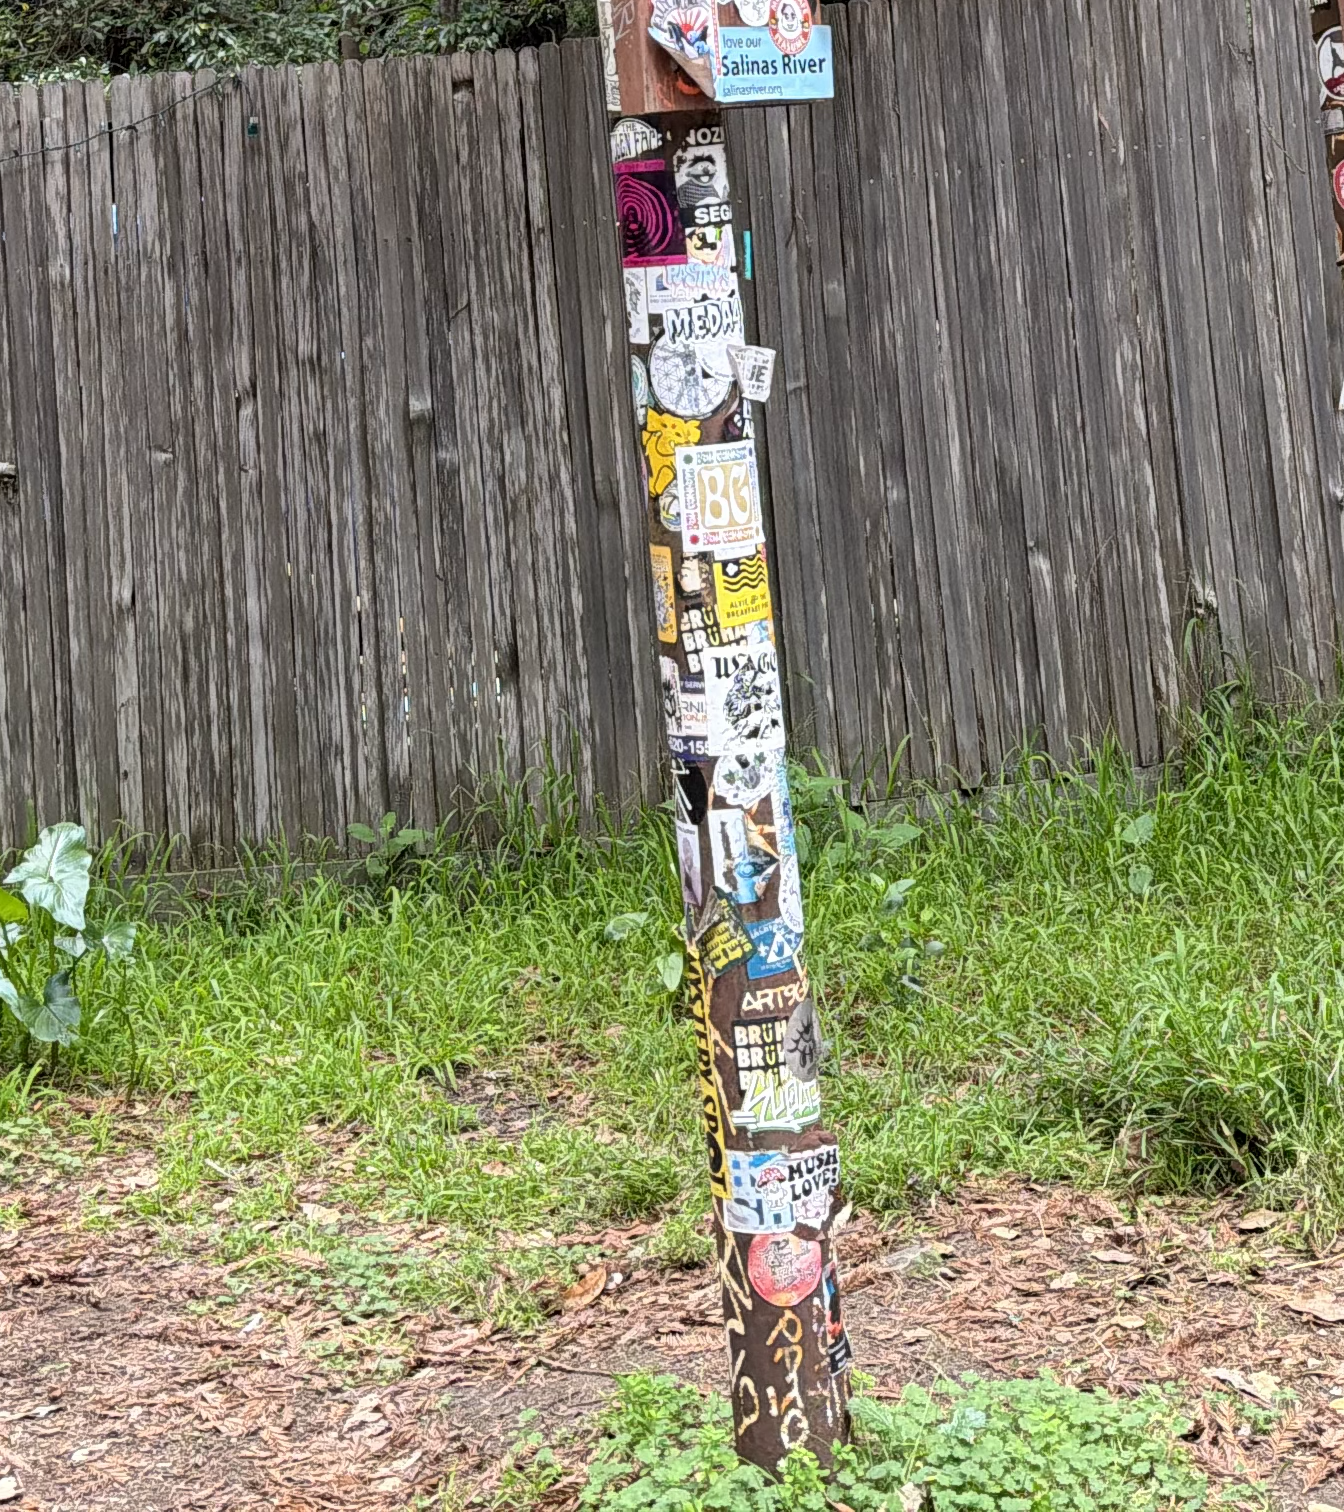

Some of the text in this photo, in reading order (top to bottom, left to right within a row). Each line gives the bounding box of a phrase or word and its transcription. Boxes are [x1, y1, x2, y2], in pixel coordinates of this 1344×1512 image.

[723, 34, 743, 49] love
[745, 37, 762, 48] our
[722, 54, 826, 77] Salinas River
[723, 84, 783, 98] salinasriver.org
[622, 123, 636, 133] THE
[703, 1094, 727, 1195] SPOT
[787, 1148, 838, 1182] MUSH
[791, 1167, 838, 1202] LOVE!
